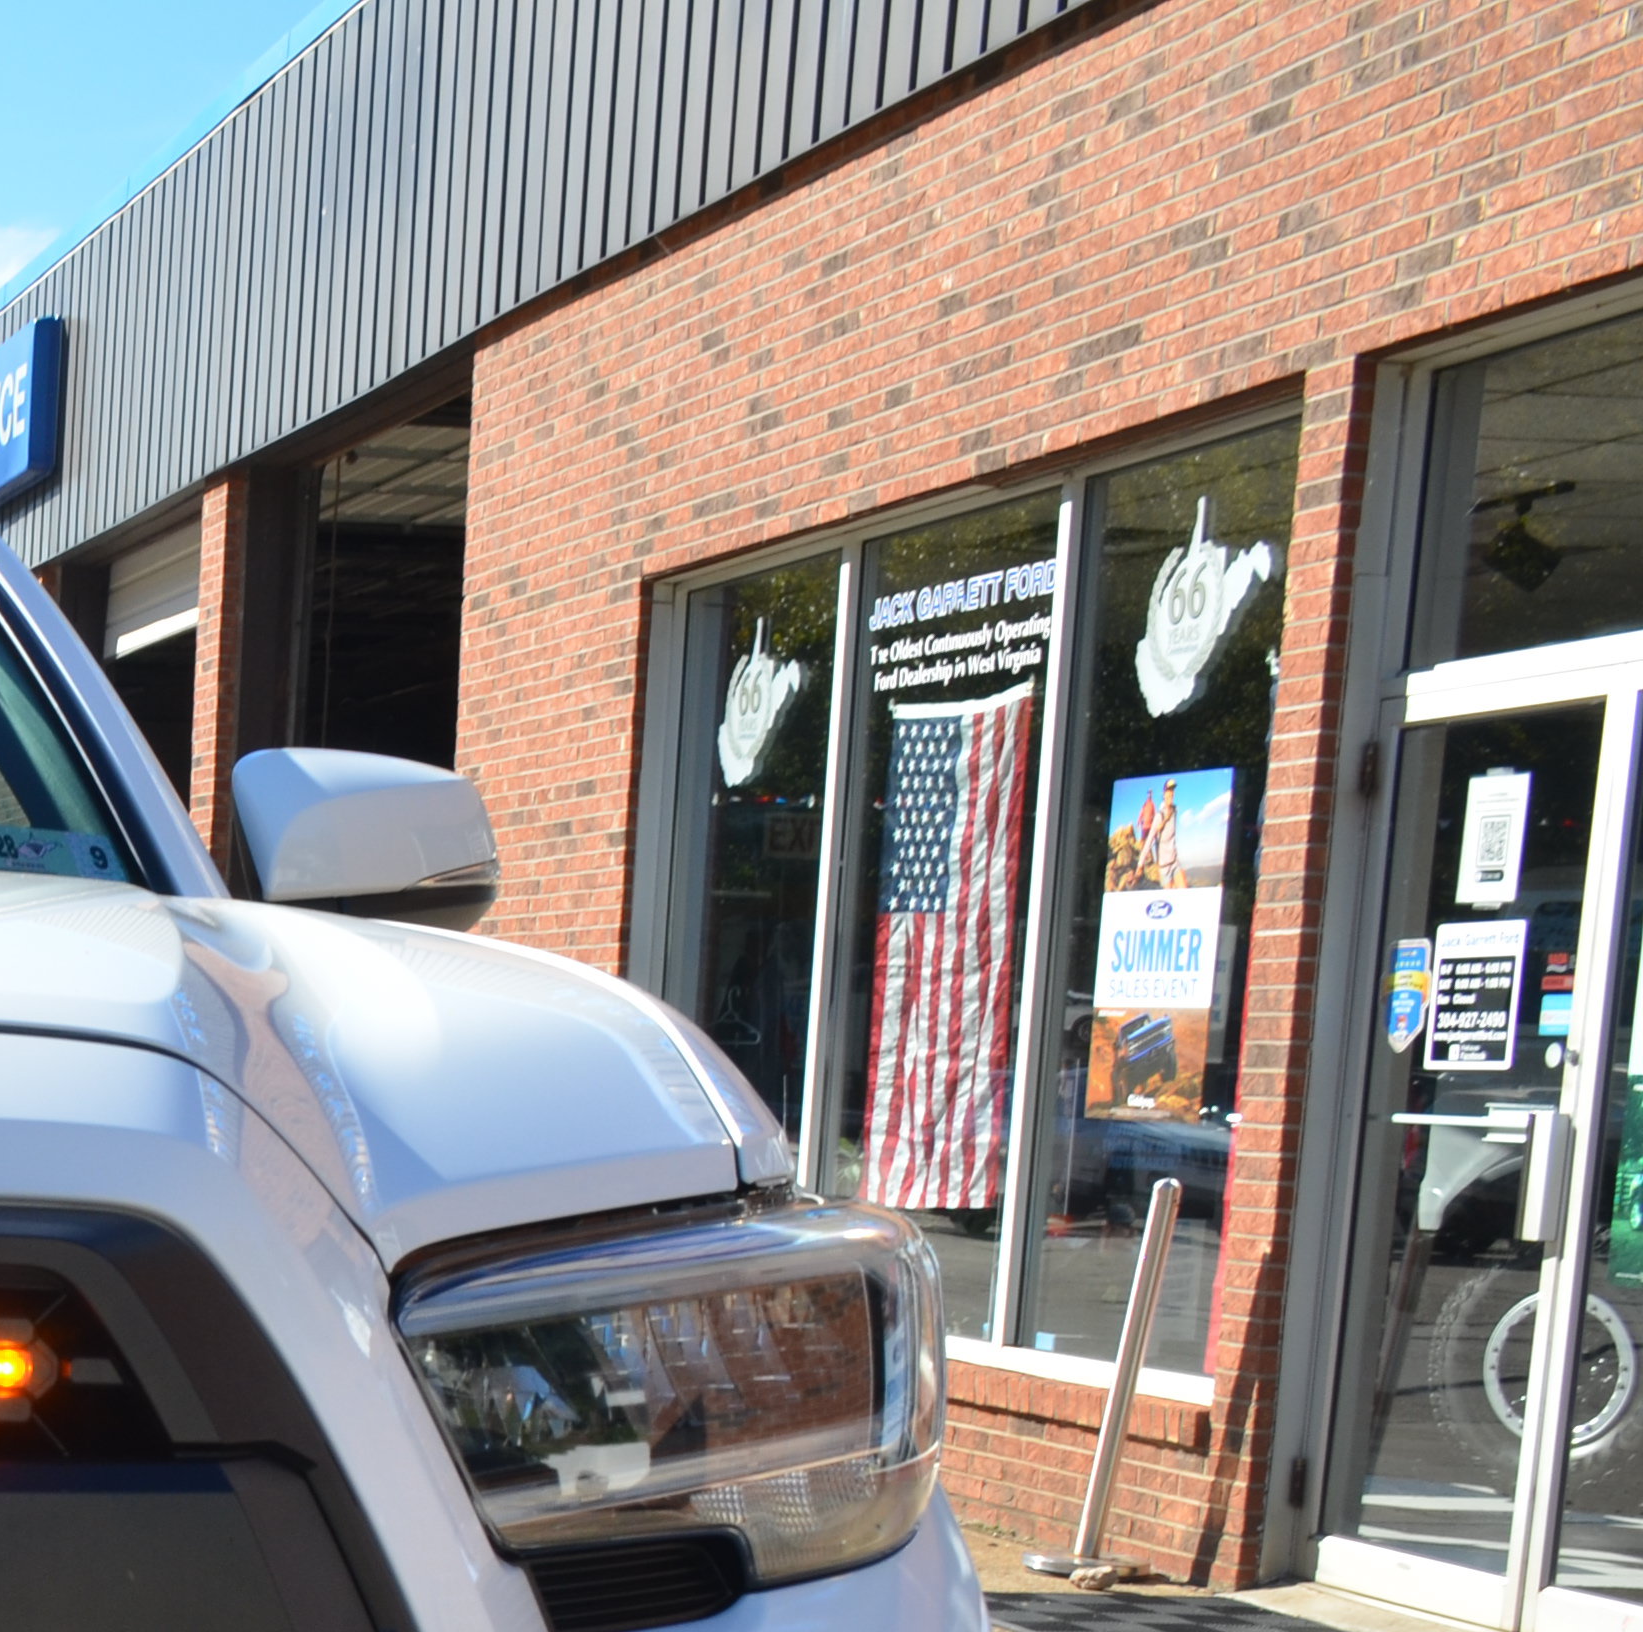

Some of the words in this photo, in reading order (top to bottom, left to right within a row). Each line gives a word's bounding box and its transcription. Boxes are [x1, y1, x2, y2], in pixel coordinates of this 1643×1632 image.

[869, 589, 916, 632] JACK
[916, 569, 1004, 622] GARRETT
[1003, 557, 1056, 603] FORD
[1168, 561, 1207, 625] 66
[890, 636, 923, 663] Oldest
[924, 622, 994, 656] Continuously
[994, 612, 1052, 646] Operating
[873, 670, 898, 693] Ford
[899, 655, 954, 688] Dealership
[954, 654, 966, 678] in
[967, 651, 996, 676] West
[997, 642, 1042, 674] Virginia
[738, 670, 762, 717] 66
[89, 845, 109, 870] 9
[1111, 928, 1203, 973] SUMMER
[1108, 978, 1150, 999] SALES
[1153, 978, 1199, 999] EVENT
[1437, 1010, 1507, 1029] 304-927-2490
